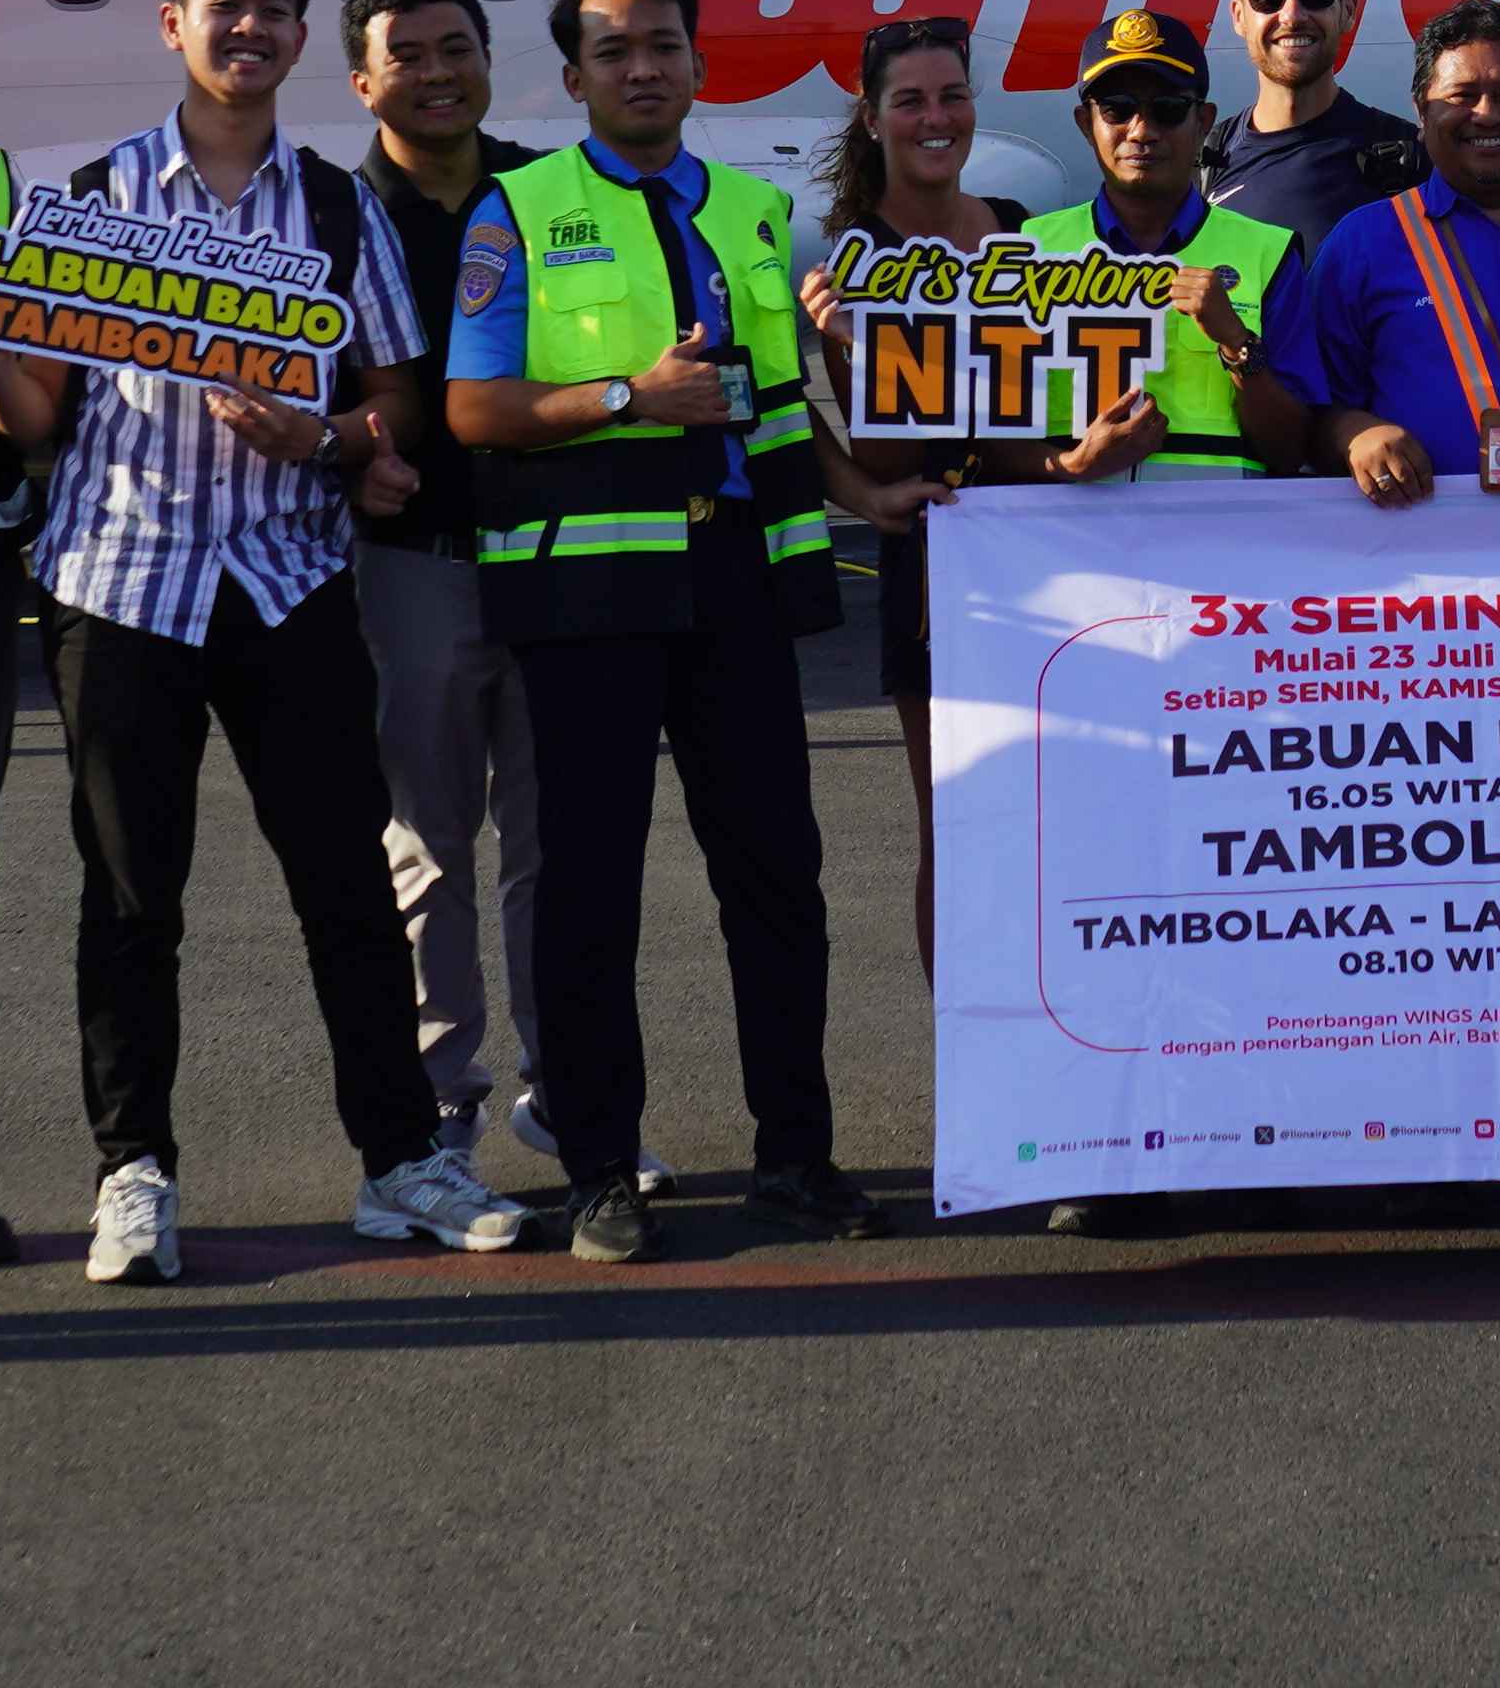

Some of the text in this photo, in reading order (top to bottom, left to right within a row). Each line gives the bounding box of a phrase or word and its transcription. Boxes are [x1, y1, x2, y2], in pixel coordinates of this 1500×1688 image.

[20, 185, 327, 290] Terbang Perdana
[831, 240, 1180, 324] Let's Explore
[203, 279, 347, 347] BAJO
[864, 312, 1152, 428] NTT
[1189, 594, 1269, 637] 3x
[1253, 645, 1357, 674] Mulai
[1368, 645, 1413, 670] 23
[1427, 642, 1494, 669] Juli
[1163, 685, 1269, 712] Setiap
[1278, 680, 1391, 706] SENIN,
[1171, 718, 1474, 778] LABUAN
[1287, 783, 1394, 812] 16.05
[1073, 903, 1396, 950] TAMBOLAKA
[1338, 949, 1435, 977] 08.10
[1266, 1009, 1398, 1031] Penerbangan
[1404, 1008, 1475, 1025] WINGS
[1161, 1037, 1237, 1058] dengan
[1242, 1033, 1377, 1055] penerbangan
[1381, 1031, 1425, 1048] Lion
[1428, 1030, 1461, 1048] Air,
[1168, 1131, 1242, 1145] Lion Air Group
